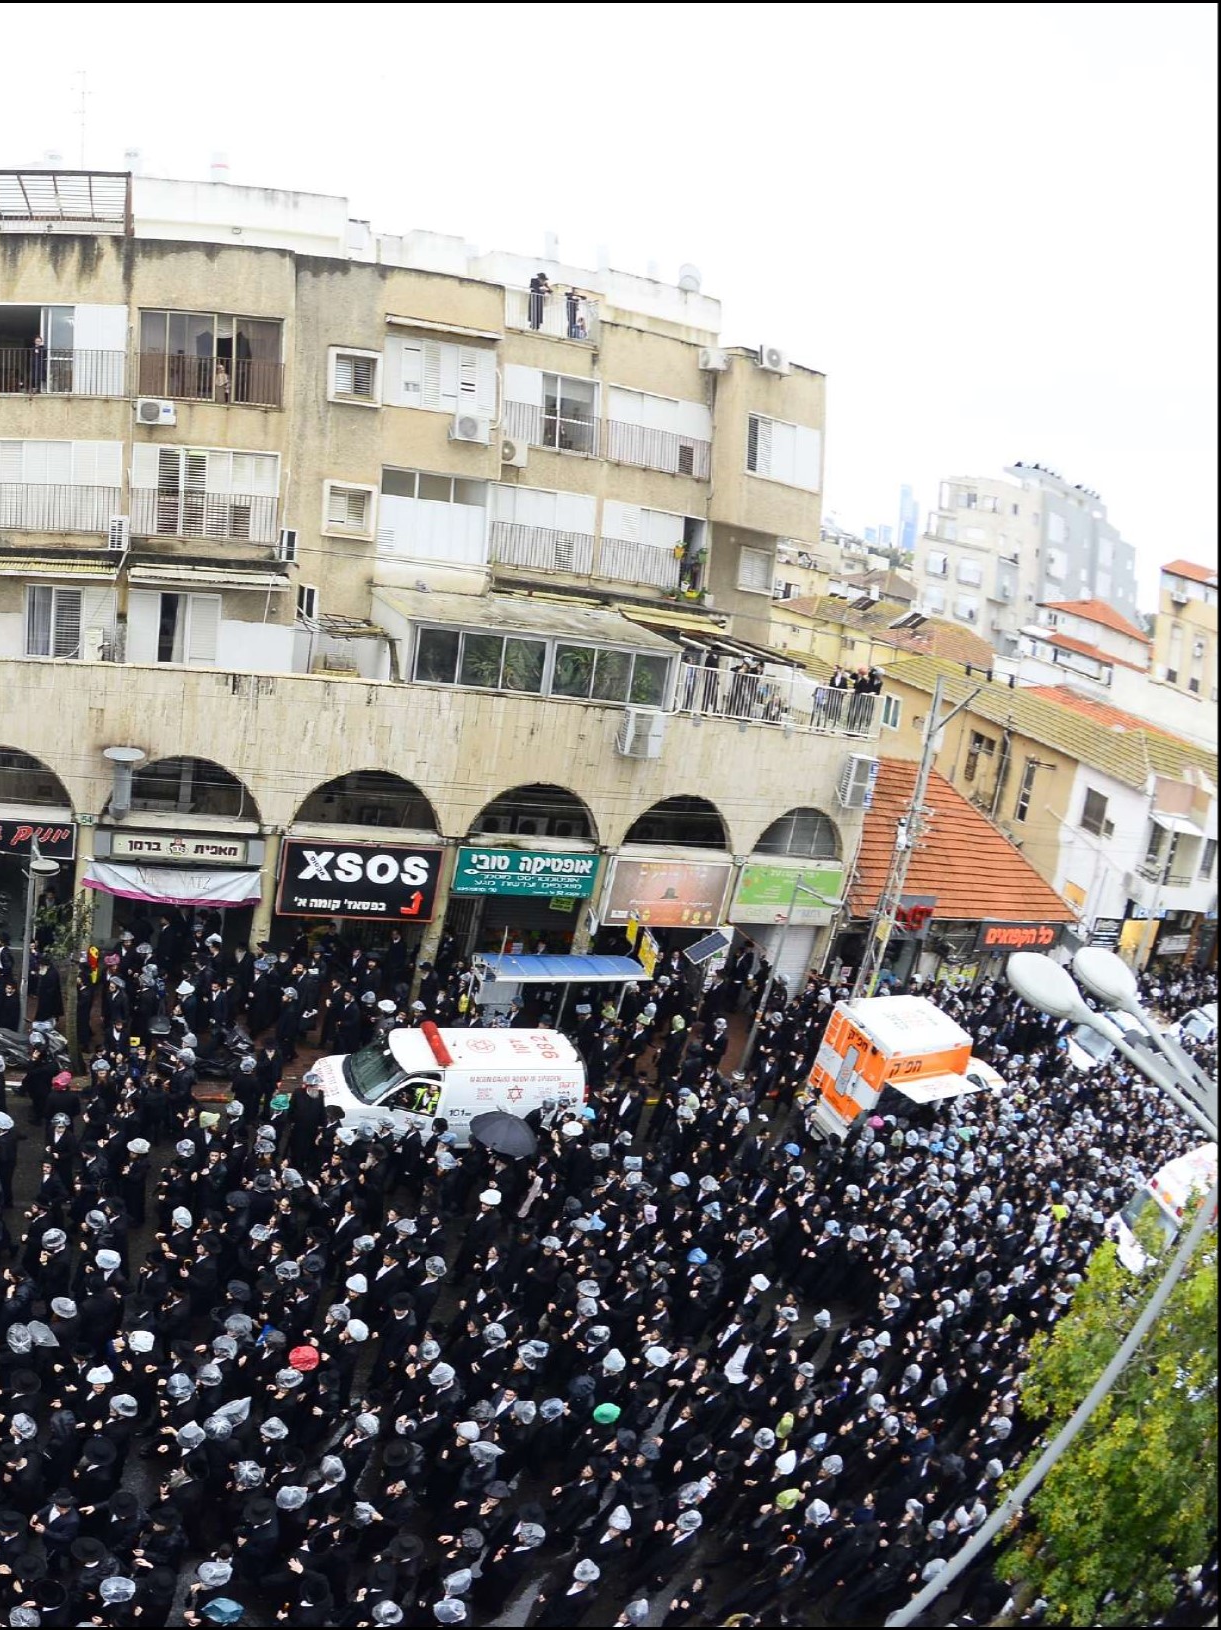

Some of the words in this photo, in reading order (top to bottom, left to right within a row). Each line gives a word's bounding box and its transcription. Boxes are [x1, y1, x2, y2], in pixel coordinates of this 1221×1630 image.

[10, 825, 71, 846] יוניק
[128, 839, 162, 852] ברמן
[193, 846, 238, 856] מאפית
[297, 850, 430, 886] XSOS
[471, 854, 510, 870] טובי
[518, 856, 593, 874] אופטיקה
[309, 898, 342, 911] קומה
[985, 928, 1037, 947] הקפואים
[1037, 926, 1053, 944] כל
